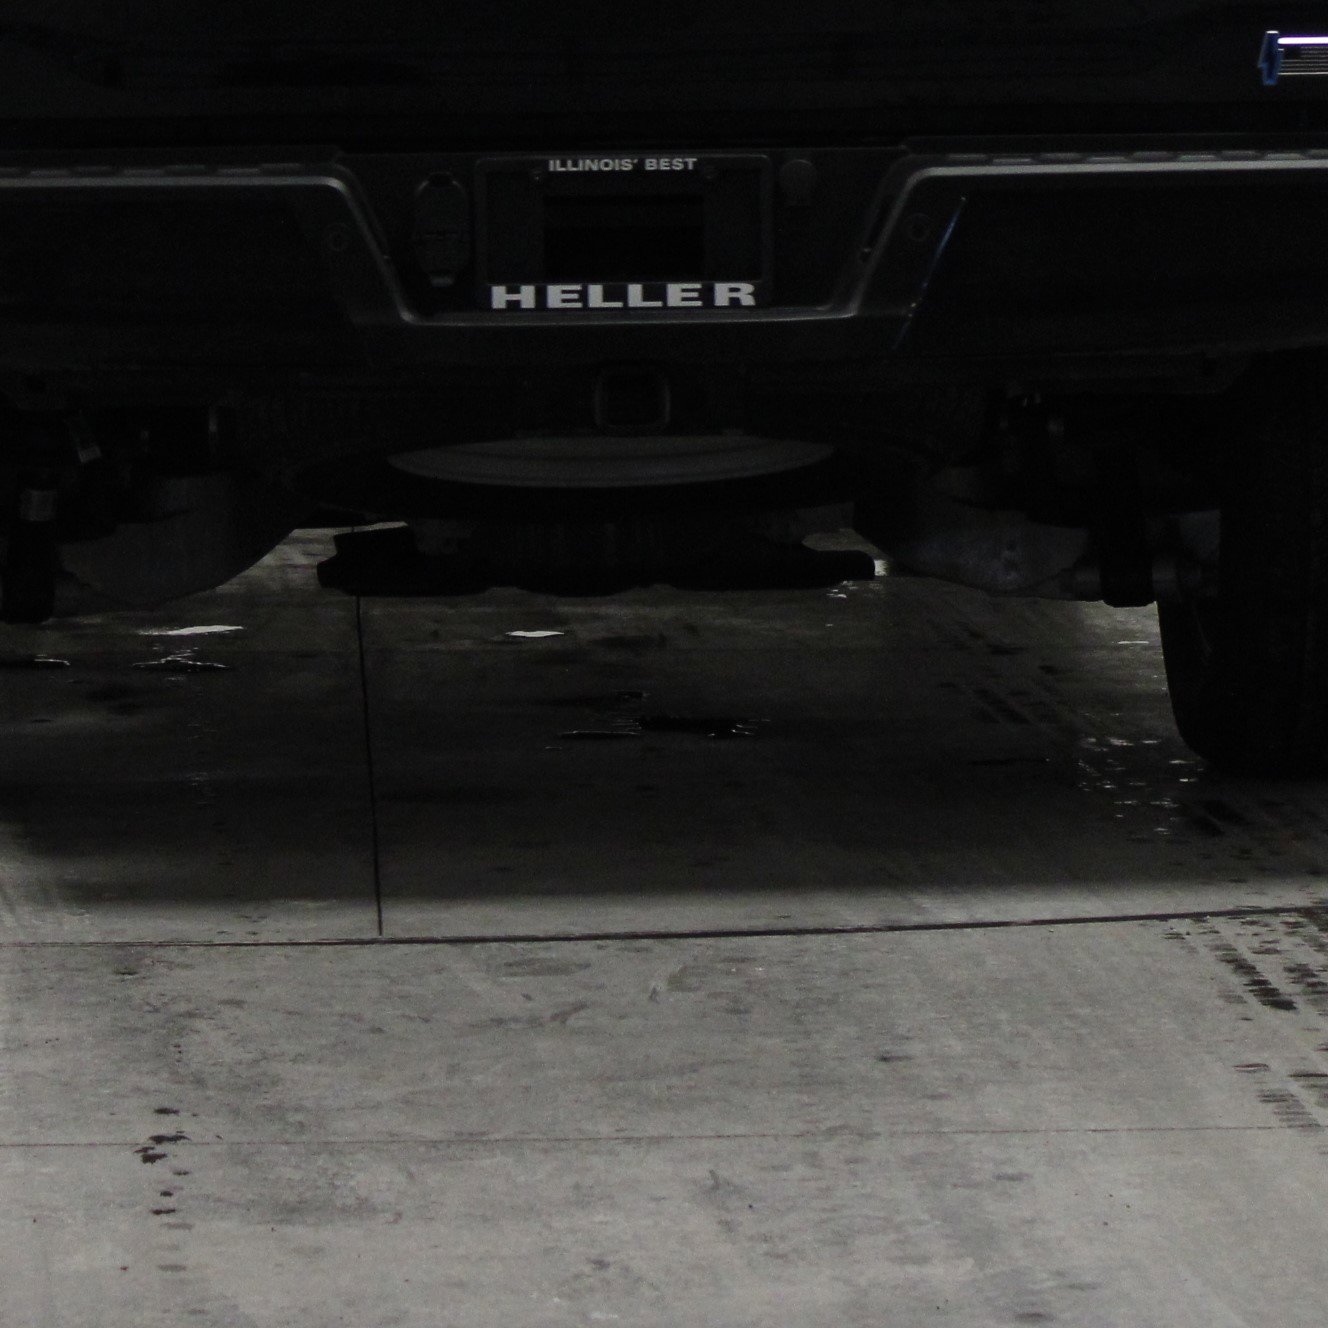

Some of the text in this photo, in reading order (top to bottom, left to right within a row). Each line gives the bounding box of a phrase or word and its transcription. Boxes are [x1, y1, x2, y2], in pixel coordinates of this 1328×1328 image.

[548, 157, 698, 172] ILLINOIS' BEST
[490, 282, 756, 309] HELLER
